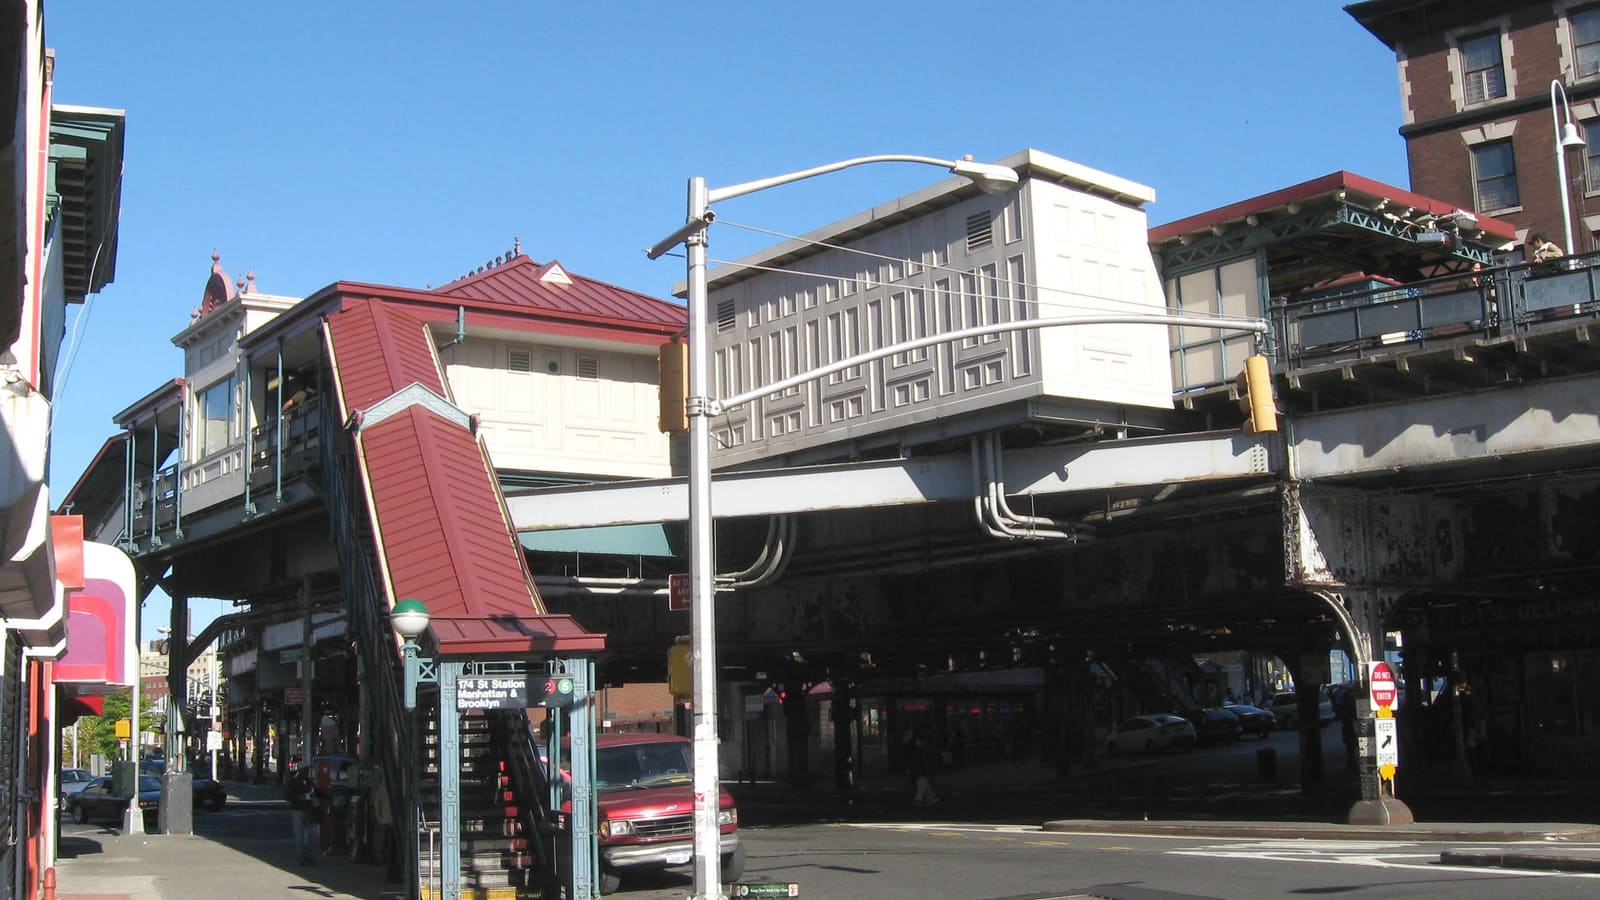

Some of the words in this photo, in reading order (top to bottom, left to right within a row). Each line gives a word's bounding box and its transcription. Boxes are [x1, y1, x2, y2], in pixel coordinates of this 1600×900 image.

[1374, 671, 1382, 680] DO
[1382, 671, 1391, 680] NOT
[458, 680, 475, 689] 174
[477, 680, 489, 689] St
[491, 680, 525, 689] Station
[458, 690, 507, 698] Manhattan
[510, 689, 518, 698] &
[1376, 692, 1391, 700] ENTER
[457, 698, 500, 709] Brooklyn
[1379, 722, 1393, 731] KEEP
[1379, 753, 1395, 763] RIGHT
